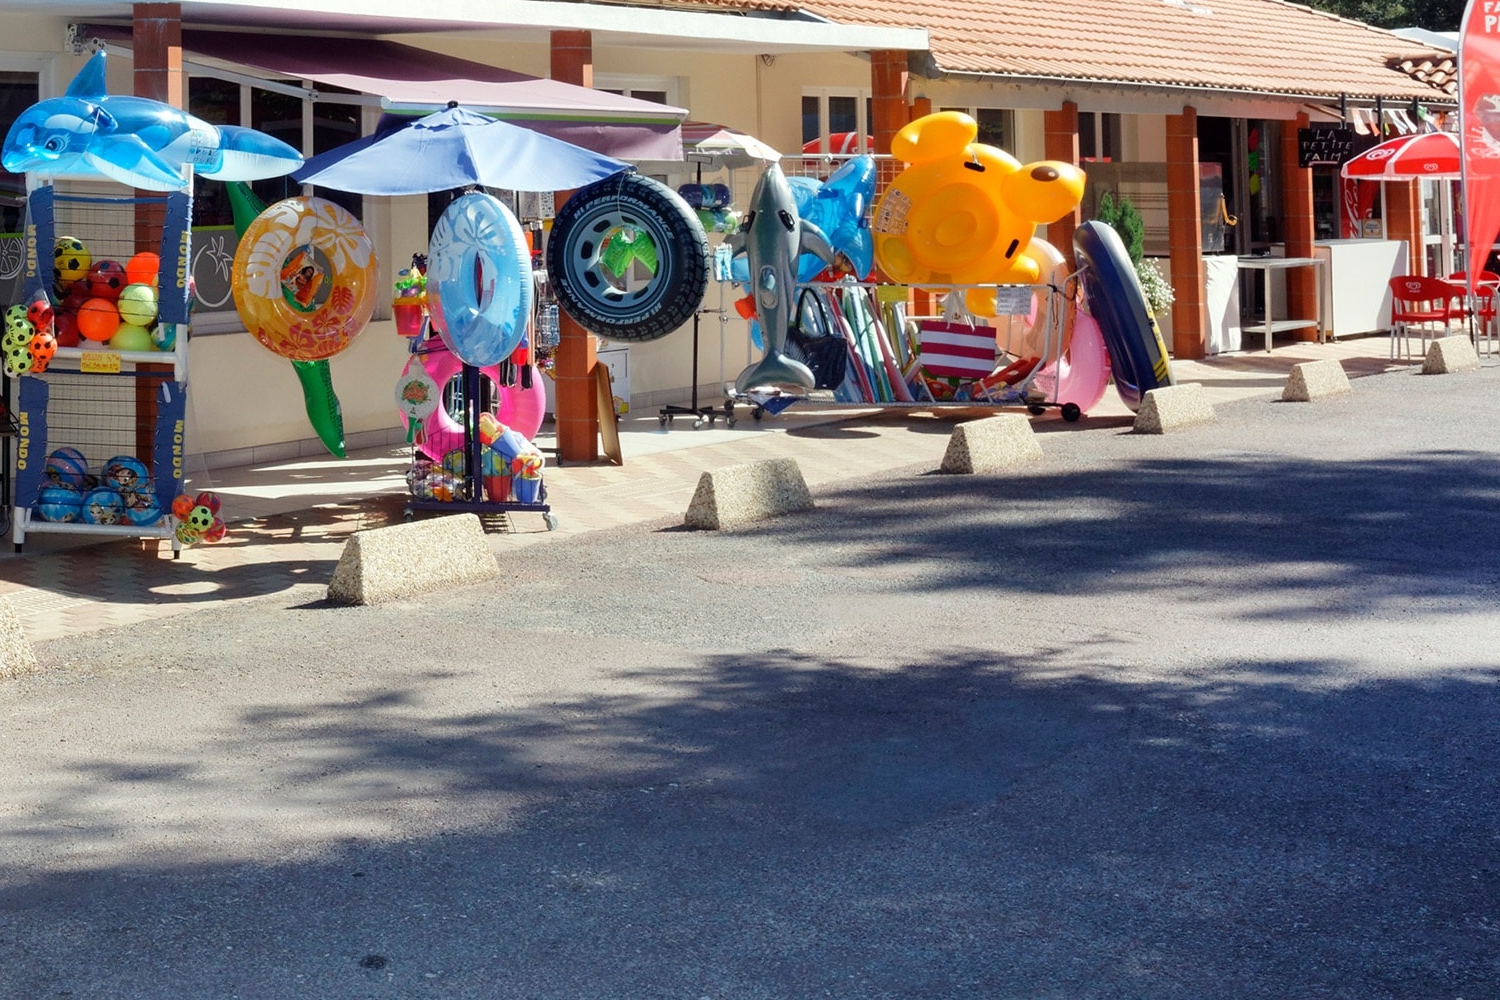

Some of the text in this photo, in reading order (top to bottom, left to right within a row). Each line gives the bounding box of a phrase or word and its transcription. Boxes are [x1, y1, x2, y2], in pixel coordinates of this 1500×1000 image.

[1485, 15, 1500, 33] P
[574, 195, 675, 240] HI PERFORMANCE
[26, 225, 37, 277] MONDO
[176, 231, 189, 288] MONDO
[561, 278, 651, 325] PERFORMANCE
[18, 412, 29, 470] MONDO
[172, 420, 184, 479] MONDO
